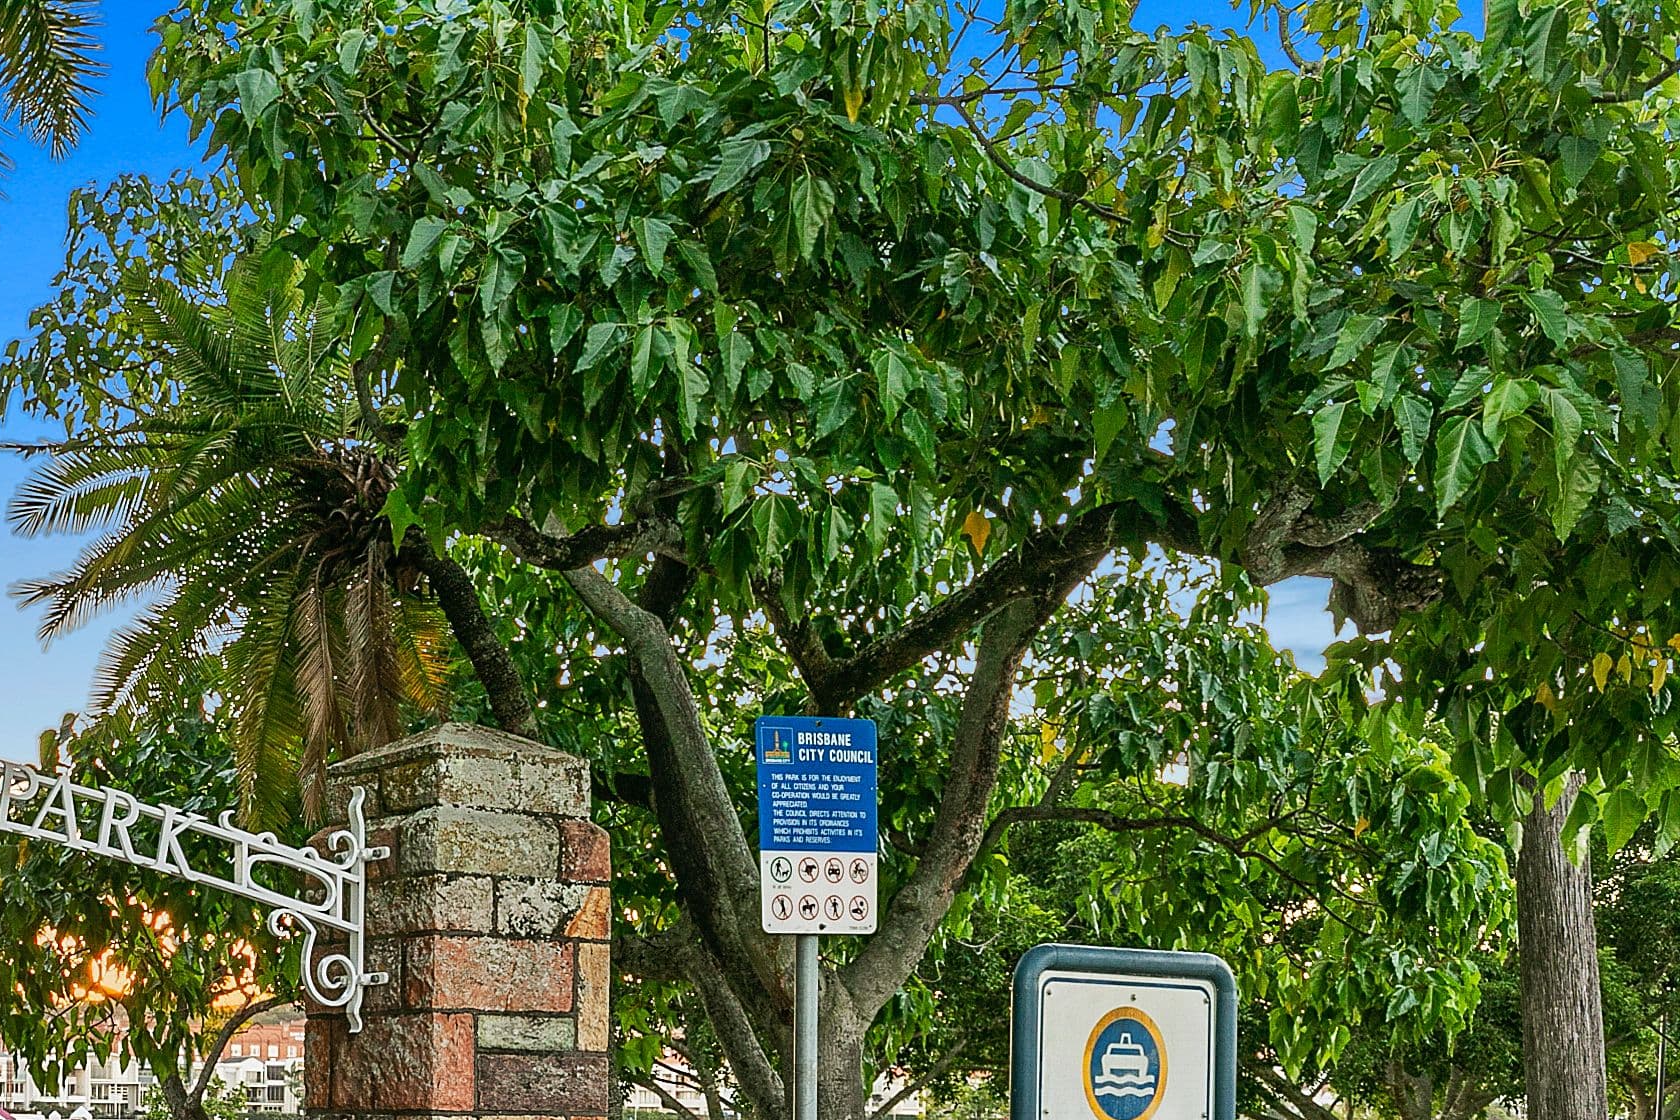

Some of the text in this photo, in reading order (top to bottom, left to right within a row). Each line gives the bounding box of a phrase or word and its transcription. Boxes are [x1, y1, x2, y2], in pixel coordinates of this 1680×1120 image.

[797, 732, 852, 747] BRISBANE
[798, 748, 874, 764] CITY COUNCIL
[833, 775, 861, 783] ENJOYMENT
[793, 783, 816, 791] CITIZENS
[772, 791, 809, 799] CO-OPERATION
[811, 792, 830, 800] WOULD
[840, 793, 861, 801] GREATLY
[773, 809, 866, 819] THE COUNCIL DIRECTS ATTENTION TO
[773, 818, 800, 826] PROVISION
[773, 827, 791, 835] WHICH
[820, 828, 846, 836] ACTIVITIES
